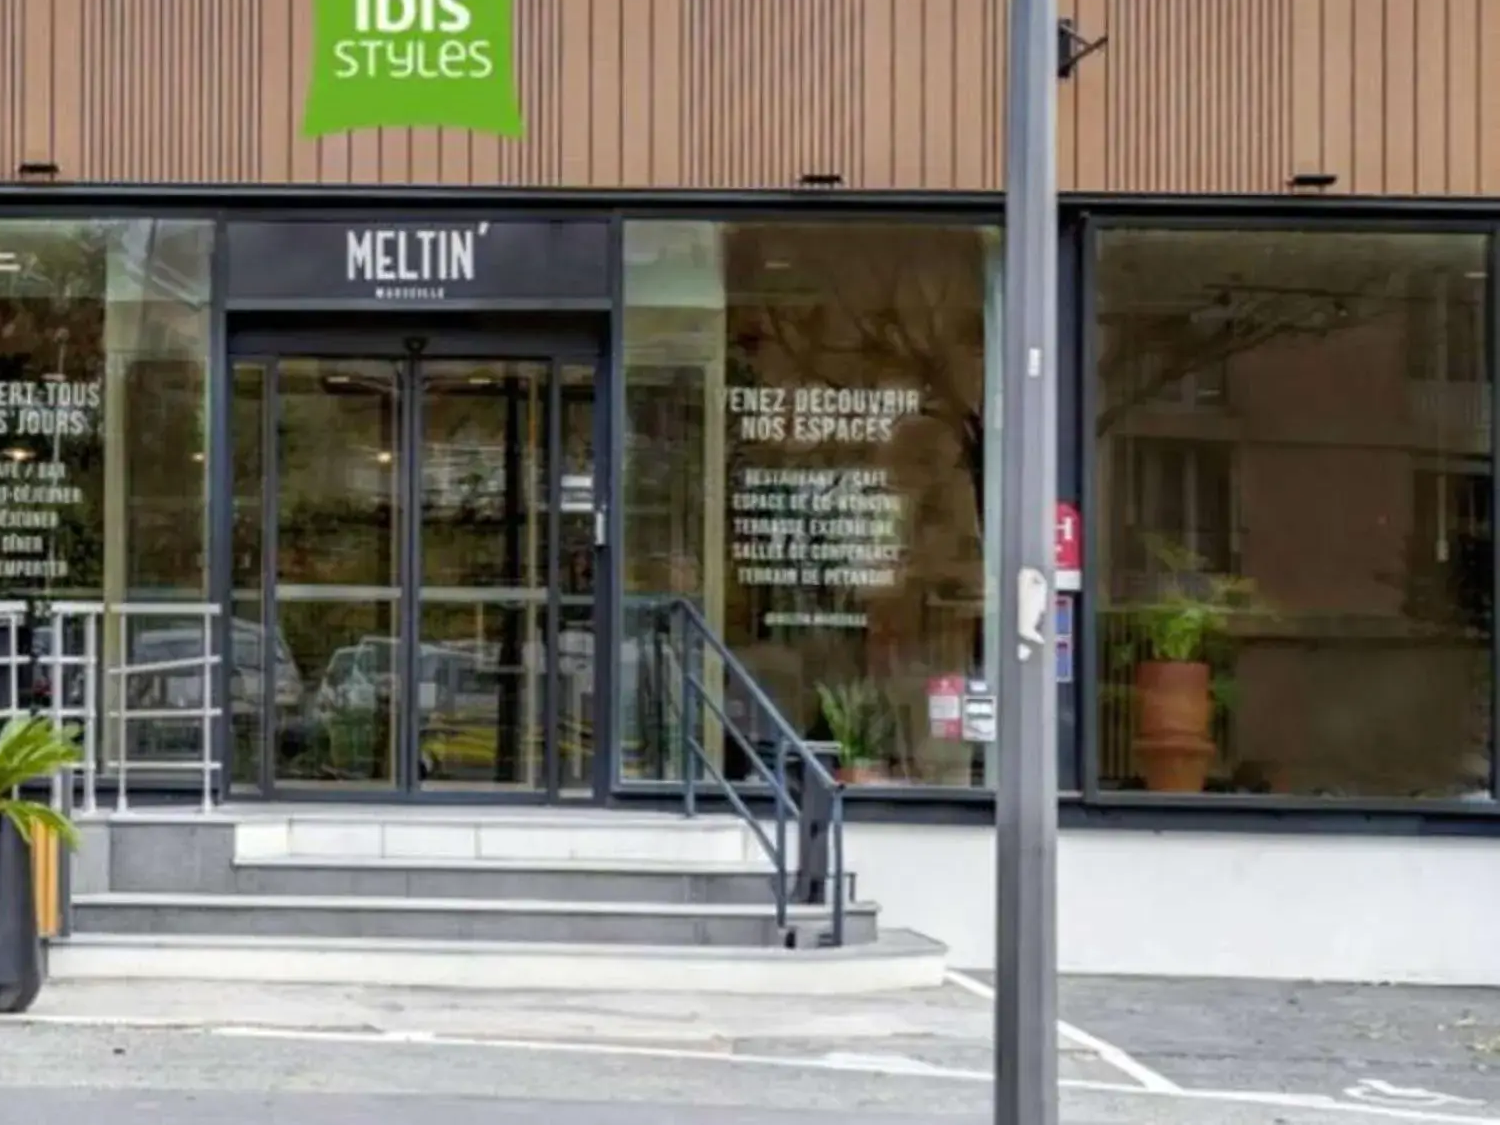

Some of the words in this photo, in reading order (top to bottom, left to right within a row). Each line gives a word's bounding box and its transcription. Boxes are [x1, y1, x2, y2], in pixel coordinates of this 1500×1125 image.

[45, 381, 100, 407] TOUS
[15, 409, 85, 434] JOURS
[741, 417, 786, 441] NOS
[794, 417, 893, 442] ESPACES
